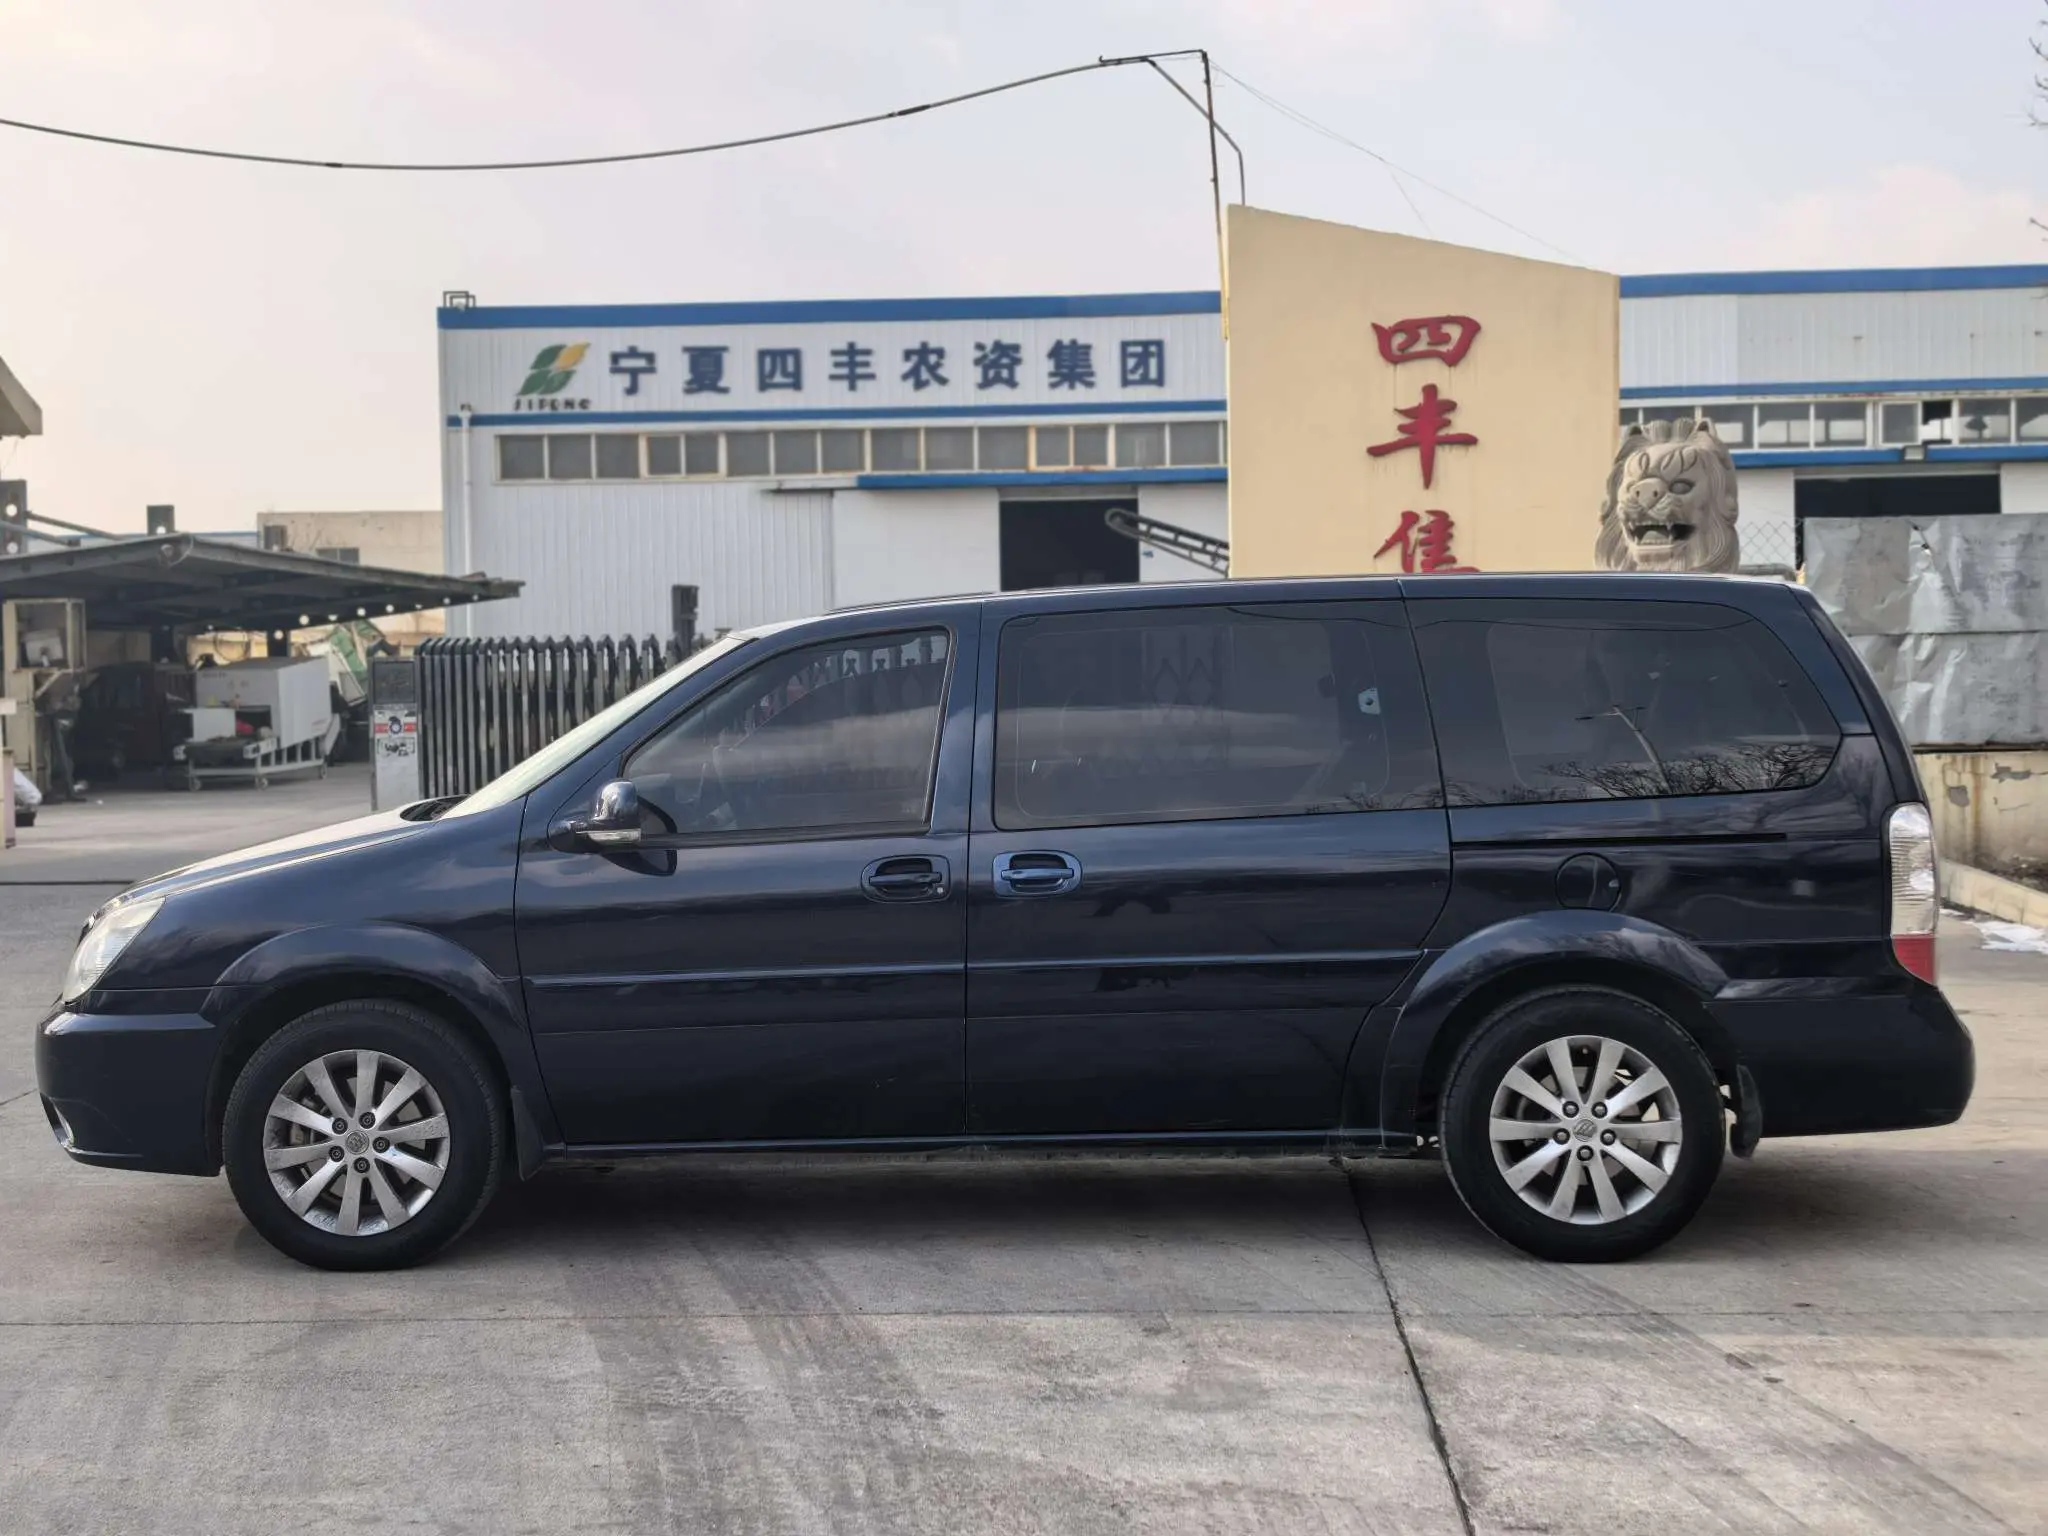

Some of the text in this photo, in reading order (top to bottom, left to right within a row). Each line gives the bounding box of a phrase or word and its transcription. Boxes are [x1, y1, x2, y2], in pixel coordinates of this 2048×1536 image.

[609, 339, 1166, 396] 宁夏四丰农资集团
